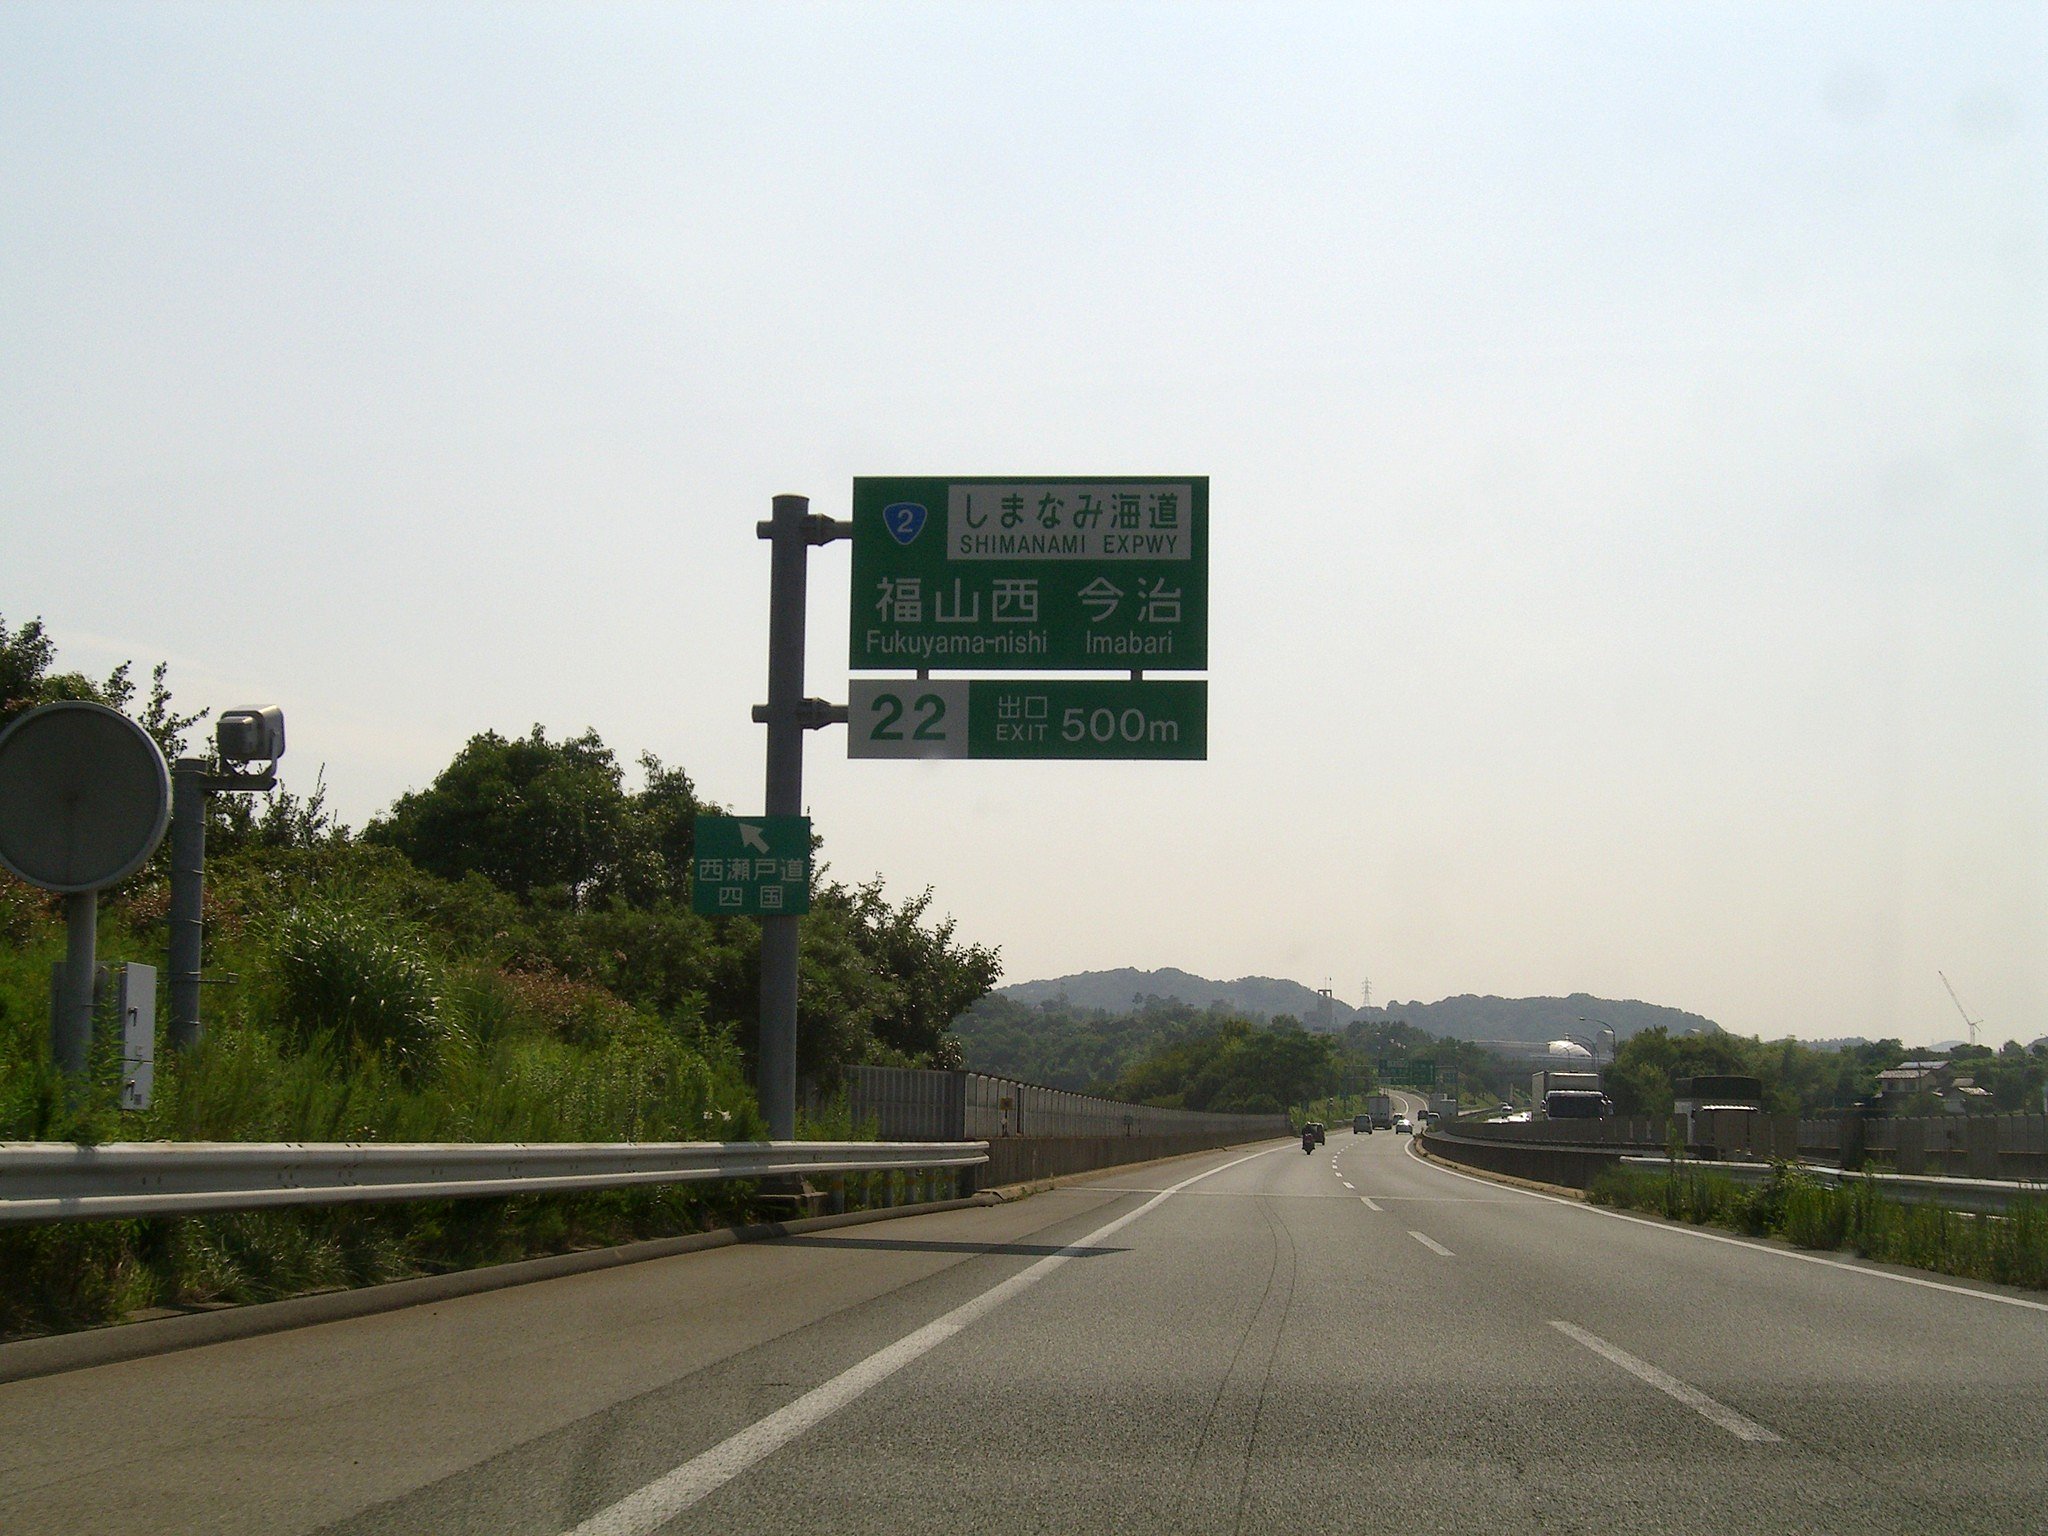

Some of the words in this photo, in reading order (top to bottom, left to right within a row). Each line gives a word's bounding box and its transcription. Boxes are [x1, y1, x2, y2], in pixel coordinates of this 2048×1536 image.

[898, 510, 913, 533] 2
[966, 492, 1179, 530] しまなみ海道
[960, 535, 1086, 554] SHIMANAMI
[1104, 535, 1178, 554] EXPWY
[875, 577, 1039, 623] 福山西
[1078, 577, 1182, 623] 今治
[866, 630, 1047, 658] Fukuyama-nishi
[1087, 630, 1172, 654] Imabari
[869, 693, 947, 741] 22
[998, 695, 1048, 719] 出口
[996, 724, 1048, 741] EXIT
[1062, 708, 1179, 742] 500m
[699, 858, 804, 882] 西瀬戸道
[719, 885, 784, 909] 四国
